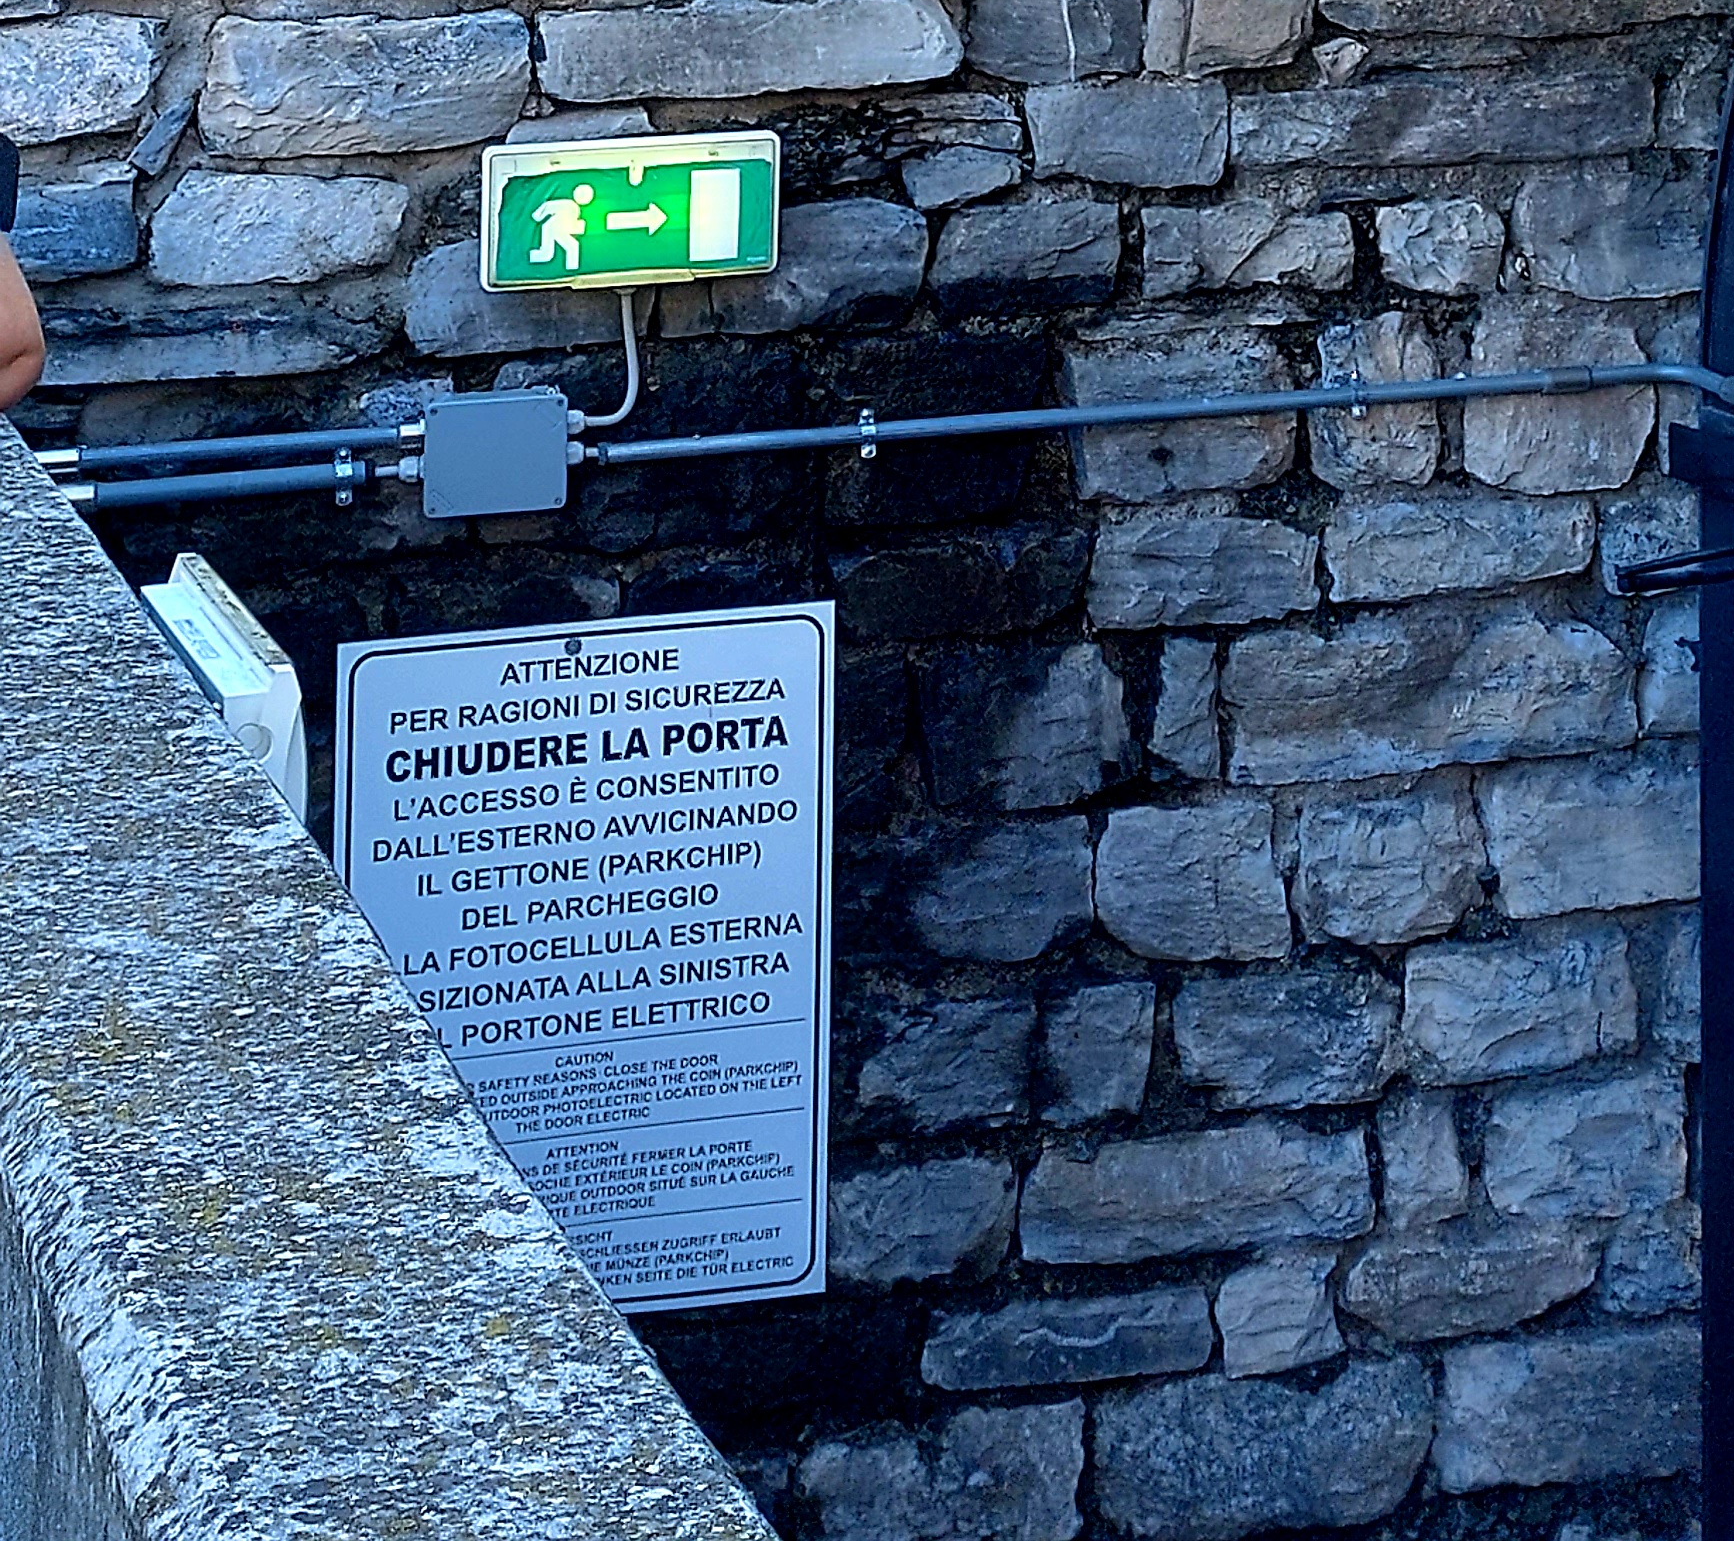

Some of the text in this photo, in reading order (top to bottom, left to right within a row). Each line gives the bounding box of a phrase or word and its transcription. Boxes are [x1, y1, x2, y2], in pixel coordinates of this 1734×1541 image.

[500, 649, 679, 685] ATTENZIONE
[391, 678, 785, 734] PER RAGIONI DI SICUREZZA
[386, 716, 788, 782] CHIUDERE LA PORTA
[394, 764, 779, 821] L'ACCESSO È CONSENTITO
[373, 800, 797, 862] DALL'ESTERNO AVVICINANDO
[417, 841, 761, 896] IL GETTONE (PARKCHIP)
[462, 884, 718, 930] DEL PARCHEGGIO
[404, 913, 803, 975] LA FOTOCELLULA ESTERNA
[577, 967, 651, 996] ALLA
[660, 952, 789, 986] SINISTRA
[462, 1010, 601, 1046] PORTONE
[612, 992, 770, 1029] ELETTRICO
[479, 1076, 529, 1093] SAFETY
[604, 1062, 647, 1078] CLOSE
[652, 1058, 676, 1071] THE
[680, 1054, 718, 1068] DOOR
[555, 1051, 613, 1067] CAUTION
[501, 1087, 559, 1105] OUTSIDE
[561, 1076, 657, 1097] APPROACHING
[661, 1073, 686, 1086] THE
[690, 1069, 721, 1083] COIN
[724, 1060, 798, 1080] (PARKCHIP)
[543, 1092, 652, 1113] PHOTOELECTRIC
[656, 1084, 716, 1101] LOCATED
[720, 1082, 738, 1094] ON
[743, 1079, 767, 1092] THE
[771, 1074, 802, 1088] LEFT
[516, 1106, 650, 1133] THE DOOR ELECTRIC
[542, 1163, 559, 1176] DE
[632, 1147, 685, 1167] FERMER
[689, 1145, 706, 1158] LA
[709, 1140, 752, 1156] PORTE
[547, 1141, 619, 1159] ATTENTION
[652, 1164, 667, 1177] LE
[671, 1161, 703, 1174] COIN
[580, 1182, 645, 1200] OUTDOOR
[690, 1174, 716, 1187] SUR
[720, 1172, 737, 1184] LA
[740, 1165, 794, 1182] GAUCHE
[636, 1269, 672, 1283] SEITE
[677, 1266, 697, 1279] DIE
[731, 1256, 793, 1273] ELECTRIC
